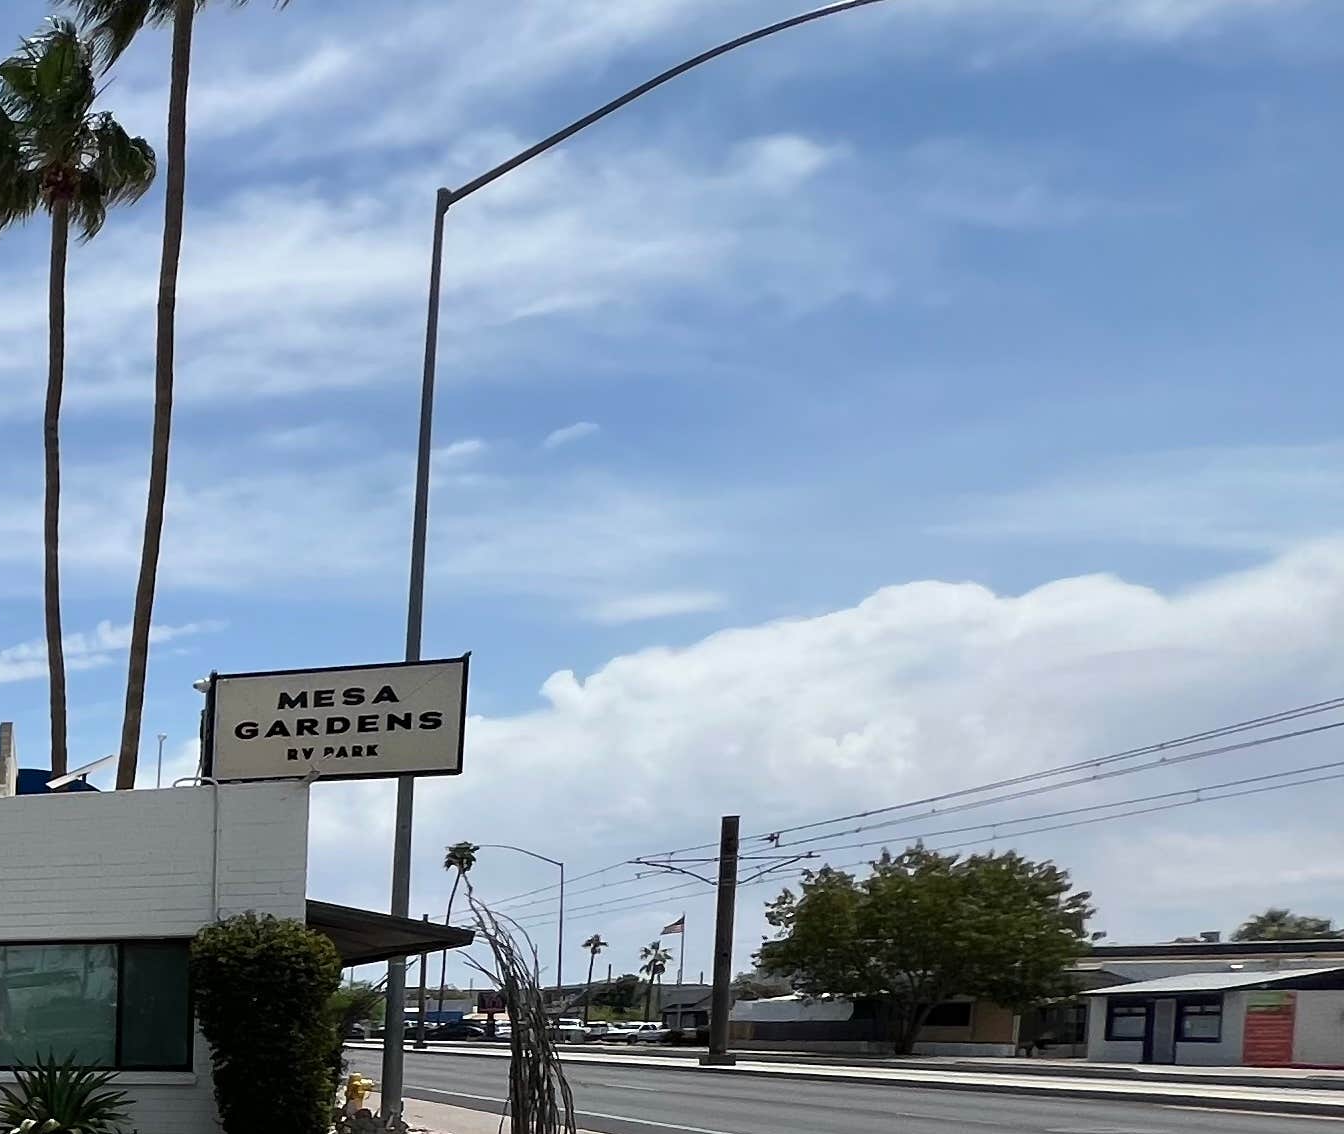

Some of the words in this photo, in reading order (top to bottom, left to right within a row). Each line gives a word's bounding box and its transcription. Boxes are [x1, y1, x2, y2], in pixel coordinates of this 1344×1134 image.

[277, 685, 400, 709] MESA
[234, 711, 443, 740] GARDENS
[287, 747, 315, 761] RV
[323, 744, 379, 759] PARK
